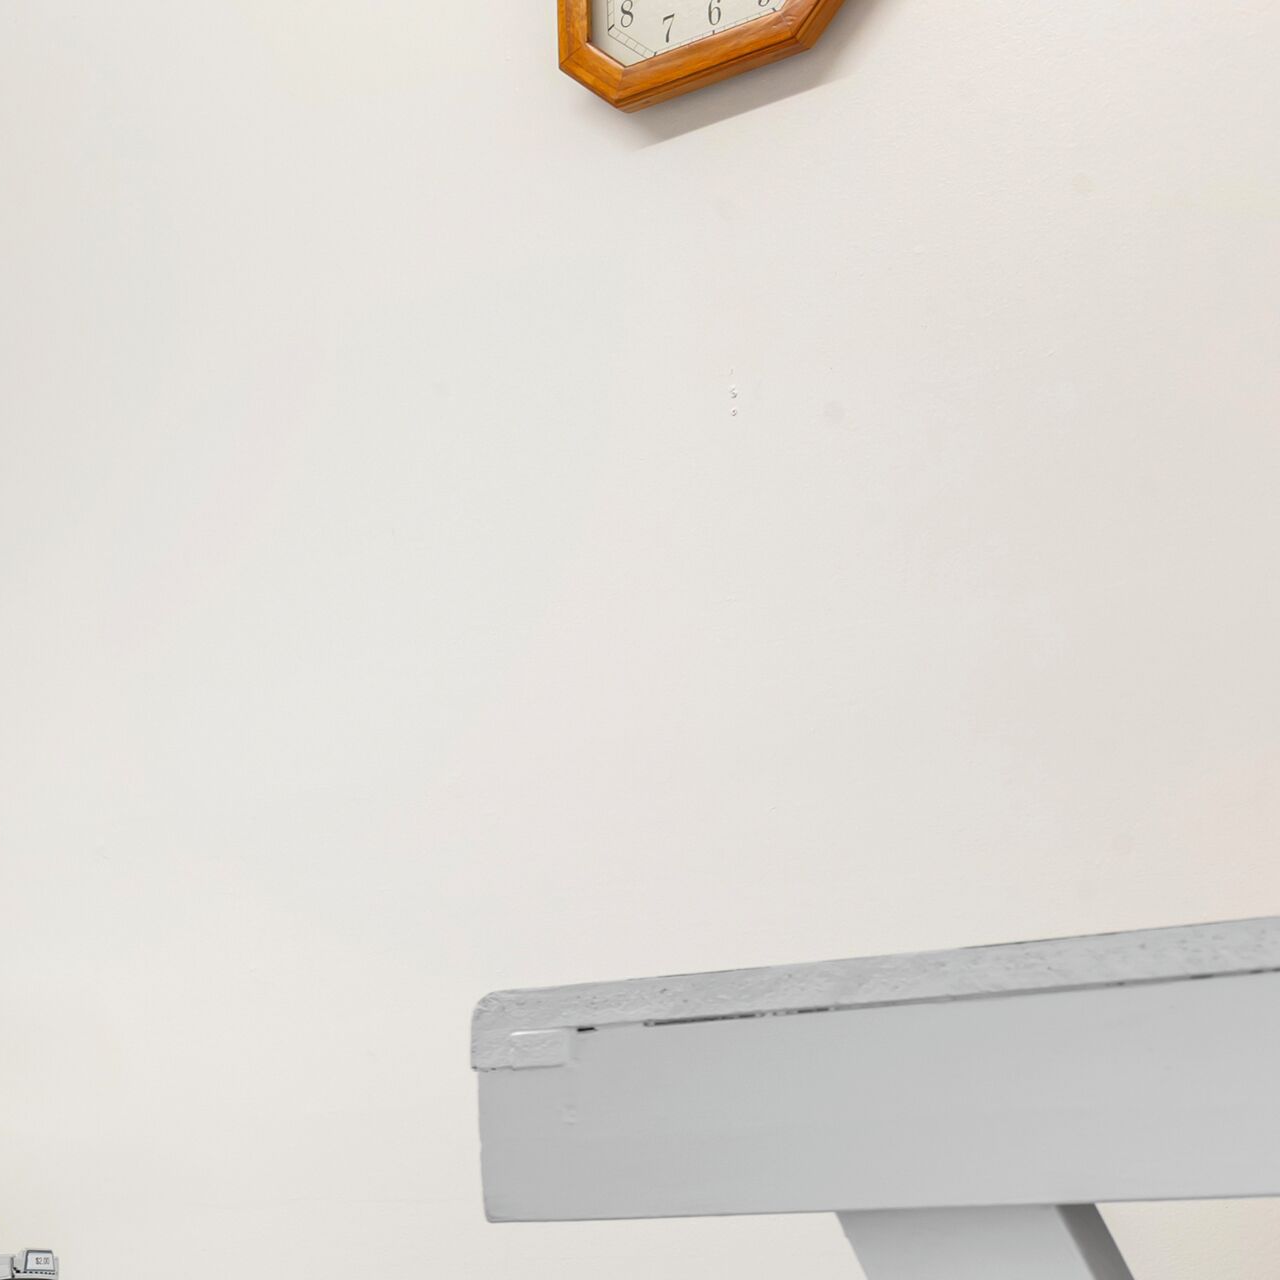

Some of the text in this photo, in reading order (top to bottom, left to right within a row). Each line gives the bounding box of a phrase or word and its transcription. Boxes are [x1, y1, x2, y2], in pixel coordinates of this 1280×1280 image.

[620, 0, 634, 28] 8
[708, 0, 722, 26] 6
[661, 13, 676, 43] 7
